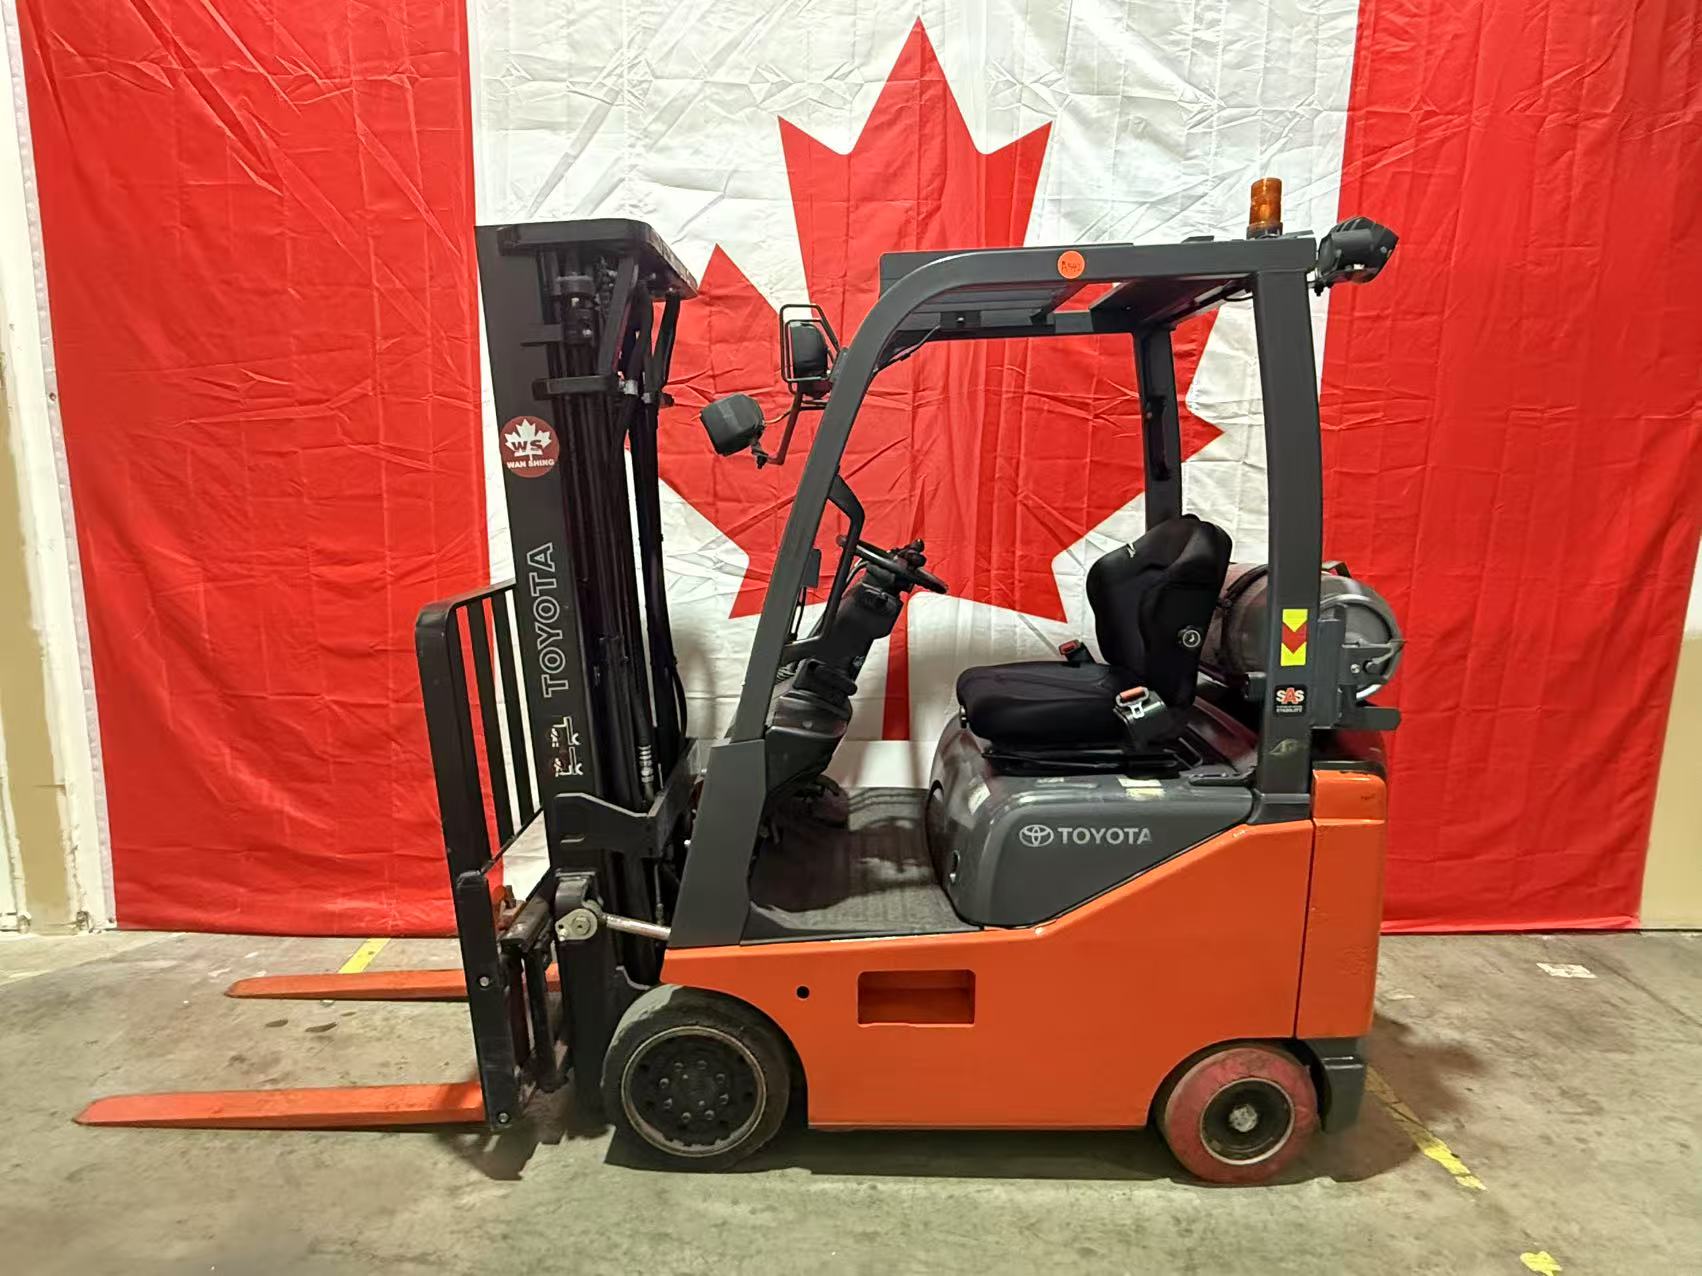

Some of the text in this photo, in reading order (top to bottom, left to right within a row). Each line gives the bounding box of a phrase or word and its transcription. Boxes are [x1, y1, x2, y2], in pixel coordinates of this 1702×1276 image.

[510, 440, 543, 453] WS
[506, 458, 555, 469] WAN SHING
[526, 542, 569, 698] TOYOTA
[1275, 687, 1305, 705] SAS
[1057, 827, 1152, 845] TOYOTA
